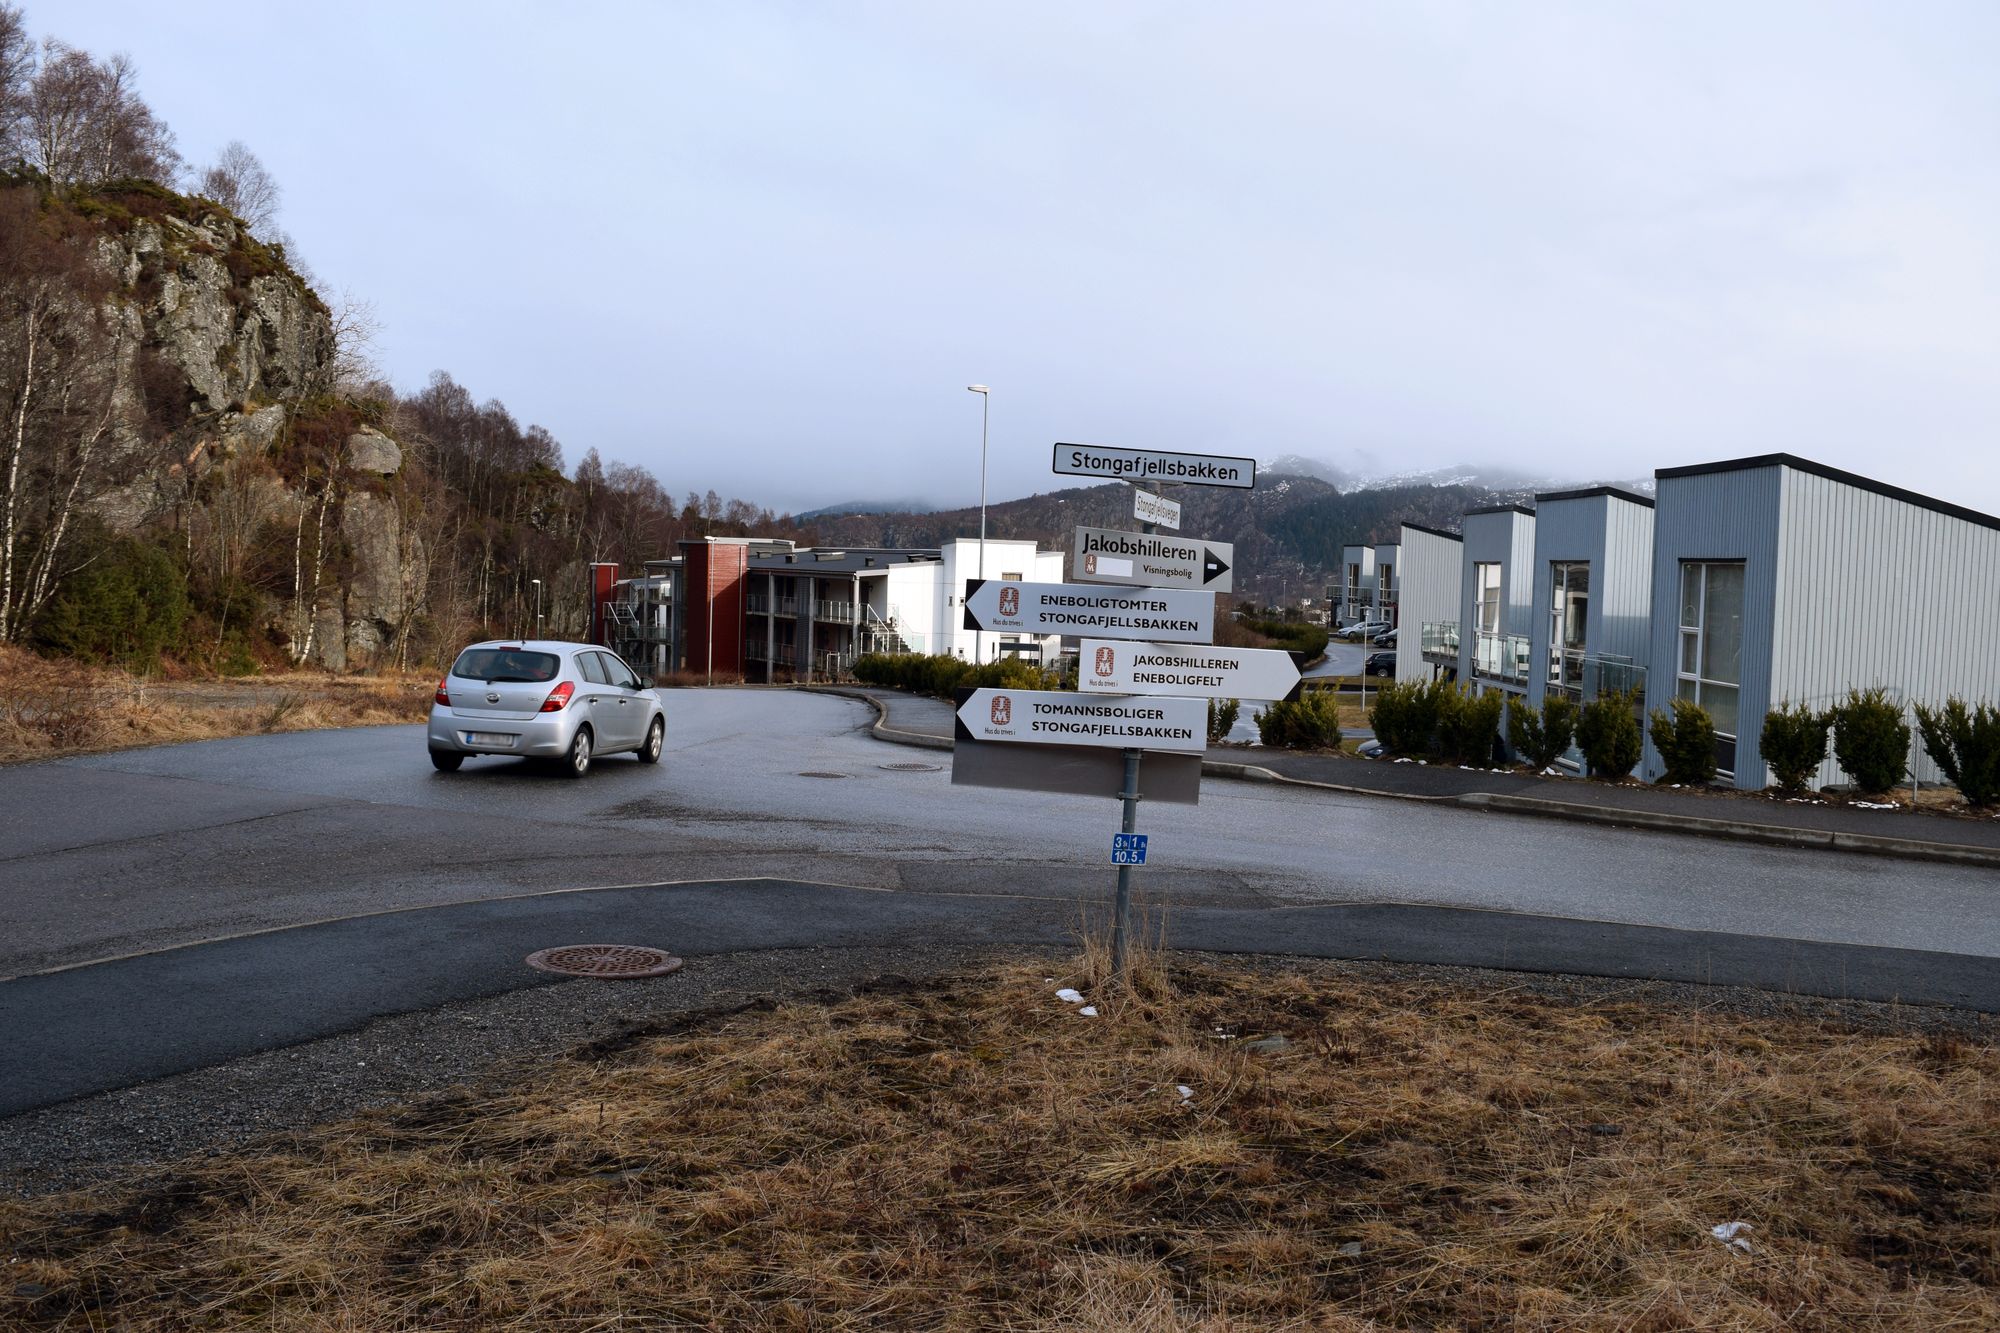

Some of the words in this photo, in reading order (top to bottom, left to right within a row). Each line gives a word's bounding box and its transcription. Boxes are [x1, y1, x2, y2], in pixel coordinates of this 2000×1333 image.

[1071, 451, 1239, 481] Stongafjellsbakken
[1082, 533, 1197, 561] Jakobshilleren
[1143, 564, 1193, 579] Visningsbolig
[1040, 595, 1168, 612] ENEBOLIGTOMTER
[1039, 612, 1199, 632] STONGAFJELLSBAKKEN
[1133, 655, 1239, 670] JAKOBSHILLEREN
[1133, 673, 1224, 687] ENEBOLIGFELT
[1033, 703, 1164, 720] TOMANNSBOLIGER
[1031, 721, 1192, 739] STONGAFJELLSBAKKEN
